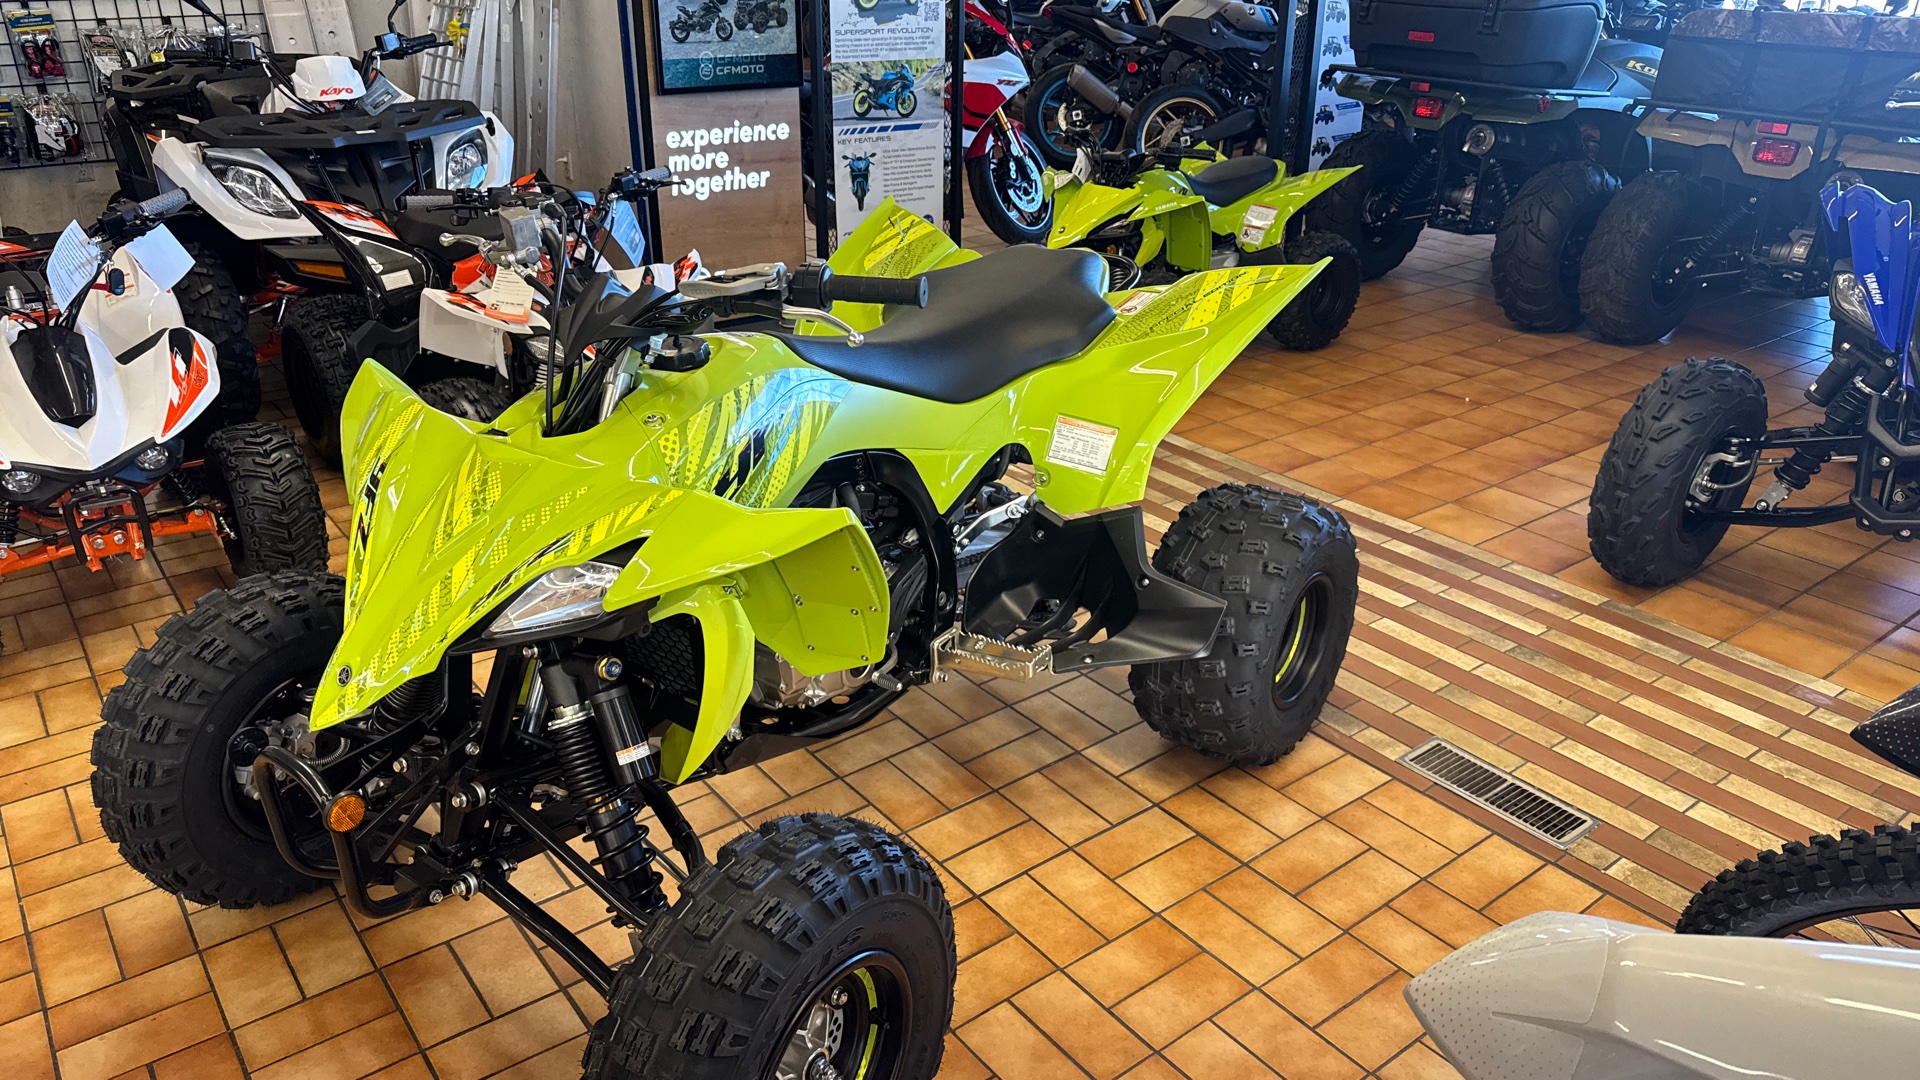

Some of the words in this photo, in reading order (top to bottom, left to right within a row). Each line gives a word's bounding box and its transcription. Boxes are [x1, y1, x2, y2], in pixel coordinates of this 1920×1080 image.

[834, 28, 885, 36] SUPERSPORT
[887, 26, 934, 34] REVOLUTION
[716, 64, 764, 75] CFMOTO
[319, 86, 353, 97] KAYO
[666, 119, 790, 153] experience
[668, 151, 729, 172] more
[671, 166, 771, 201] together
[1863, 272, 1885, 306] YAMAHA
